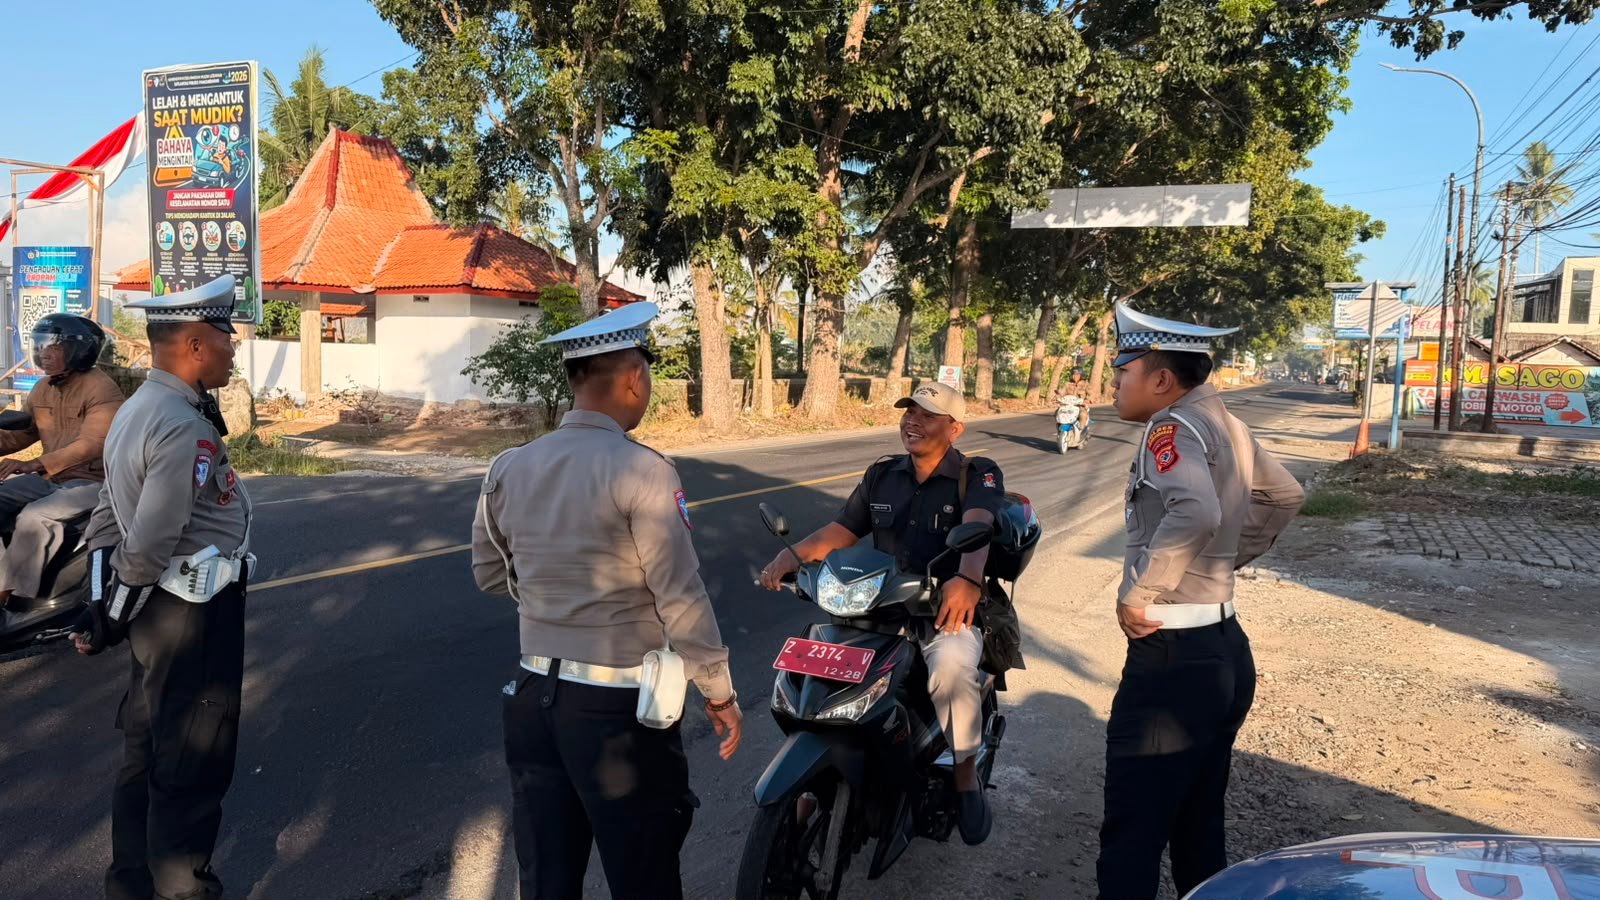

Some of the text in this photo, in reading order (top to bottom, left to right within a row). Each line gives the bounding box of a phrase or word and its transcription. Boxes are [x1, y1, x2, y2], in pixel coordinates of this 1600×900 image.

[231, 71, 248, 83] 2026
[152, 90, 244, 110] LELAH & MENGANTUK
[154, 105, 244, 128] SAAT MUDIK?
[158, 139, 192, 155] BAHAYA
[19, 265, 59, 273] PENGADUAN
[25, 273, 56, 282] PROPAM
[1497, 367, 1586, 389] SAGO
[1466, 390, 1541, 403] CAWASH
[1500, 404, 1542, 413] MOTOR
[784, 640, 872, 665] Z 2374 V
